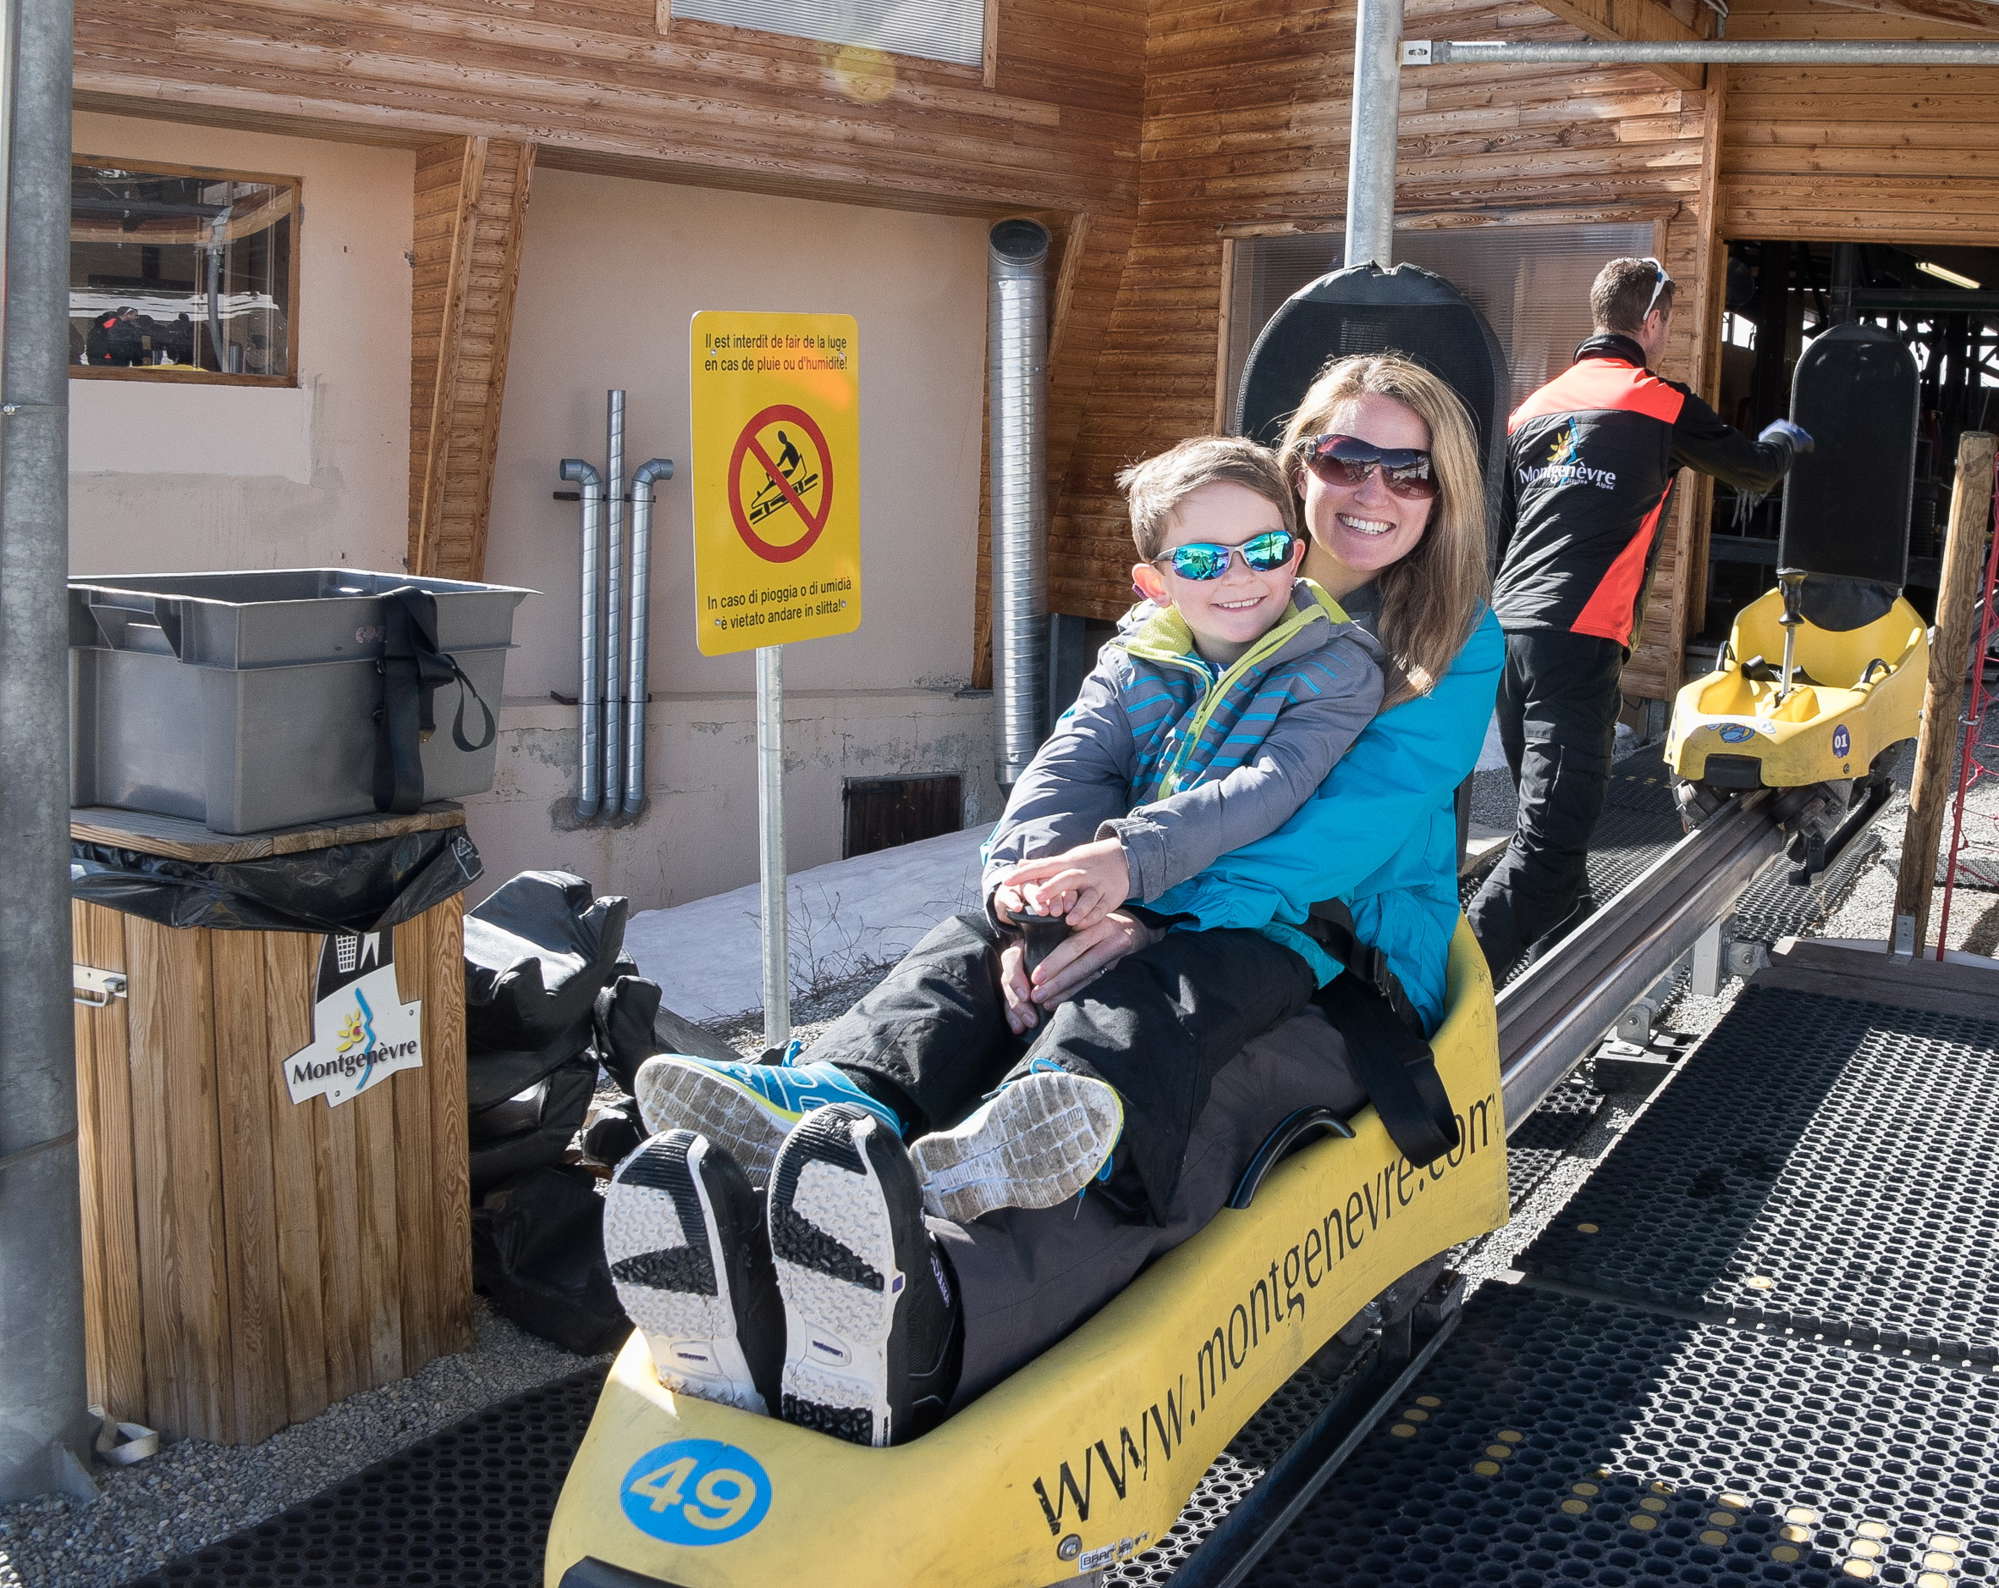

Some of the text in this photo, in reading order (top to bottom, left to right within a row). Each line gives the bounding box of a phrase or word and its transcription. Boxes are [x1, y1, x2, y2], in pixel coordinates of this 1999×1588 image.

[705, 333, 847, 351] Il est interdit de fair de la luge
[705, 359, 718, 371] en
[720, 359, 739, 371] cas
[741, 357, 754, 371] de
[757, 356, 781, 373] pluie
[783, 359, 796, 371] ou
[1519, 461, 1616, 485] Montgenèvre
[707, 596, 718, 610] In
[720, 594, 746, 608] caso
[748, 589, 758, 604] di
[761, 584, 798, 605] pioggia
[800, 585, 807, 597] o
[809, 581, 818, 595] di
[730, 612, 765, 629] vietato
[768, 607, 802, 623] andare
[804, 603, 813, 617] in
[816, 599, 841, 616] slitta!
[1834, 733, 1848, 749] 01
[293, 1040, 418, 1085] Montgenèvre
[629, 1456, 757, 1530] 49
